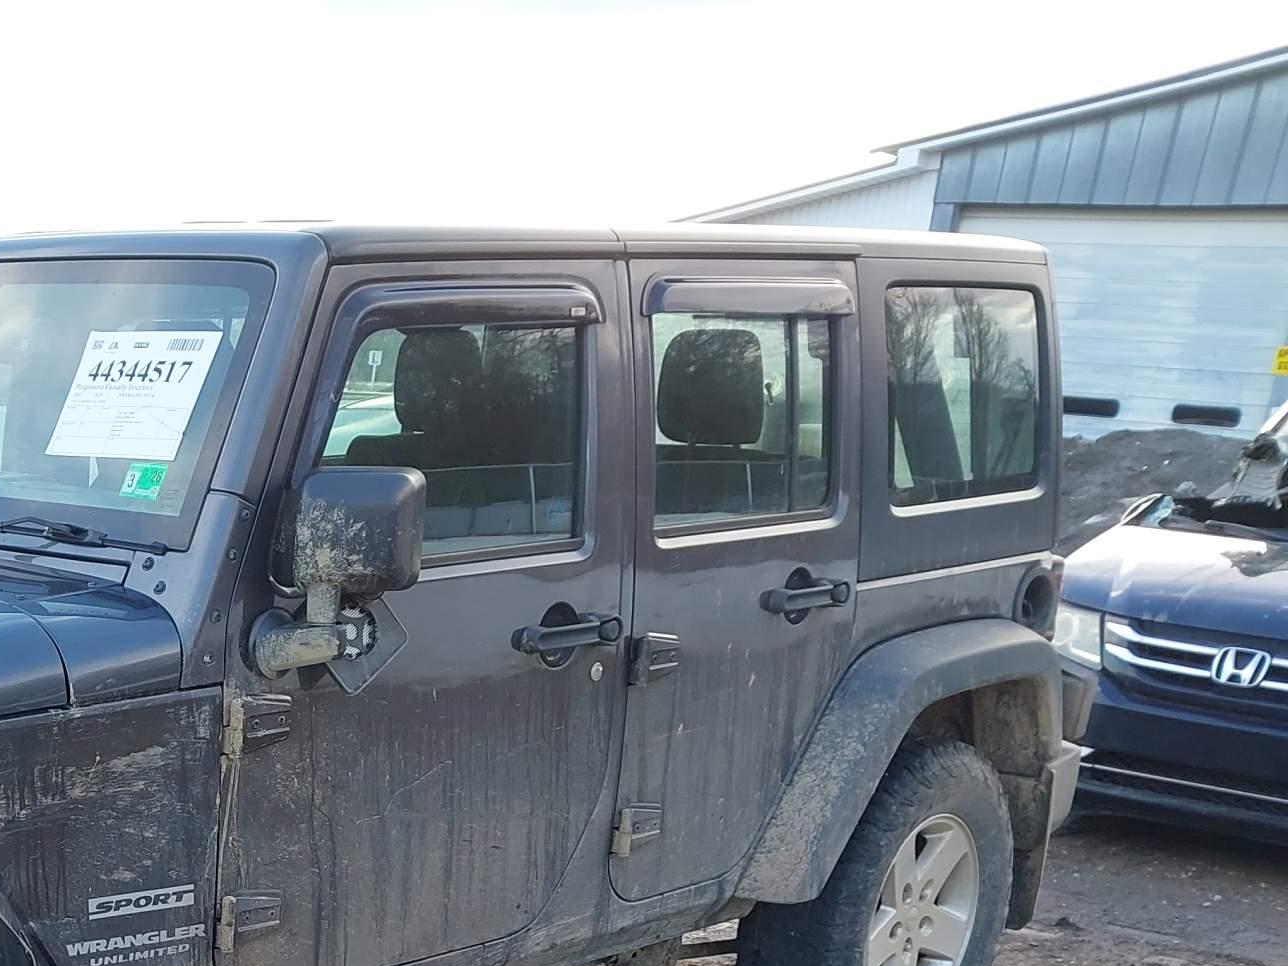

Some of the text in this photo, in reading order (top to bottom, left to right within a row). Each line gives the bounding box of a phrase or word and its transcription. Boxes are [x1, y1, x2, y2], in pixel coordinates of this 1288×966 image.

[88, 360, 194, 383] 44344517
[127, 473, 136, 488] 3
[150, 470, 164, 485] 26
[92, 889, 193, 915] SPORT
[66, 923, 206, 957] WRANGLER
